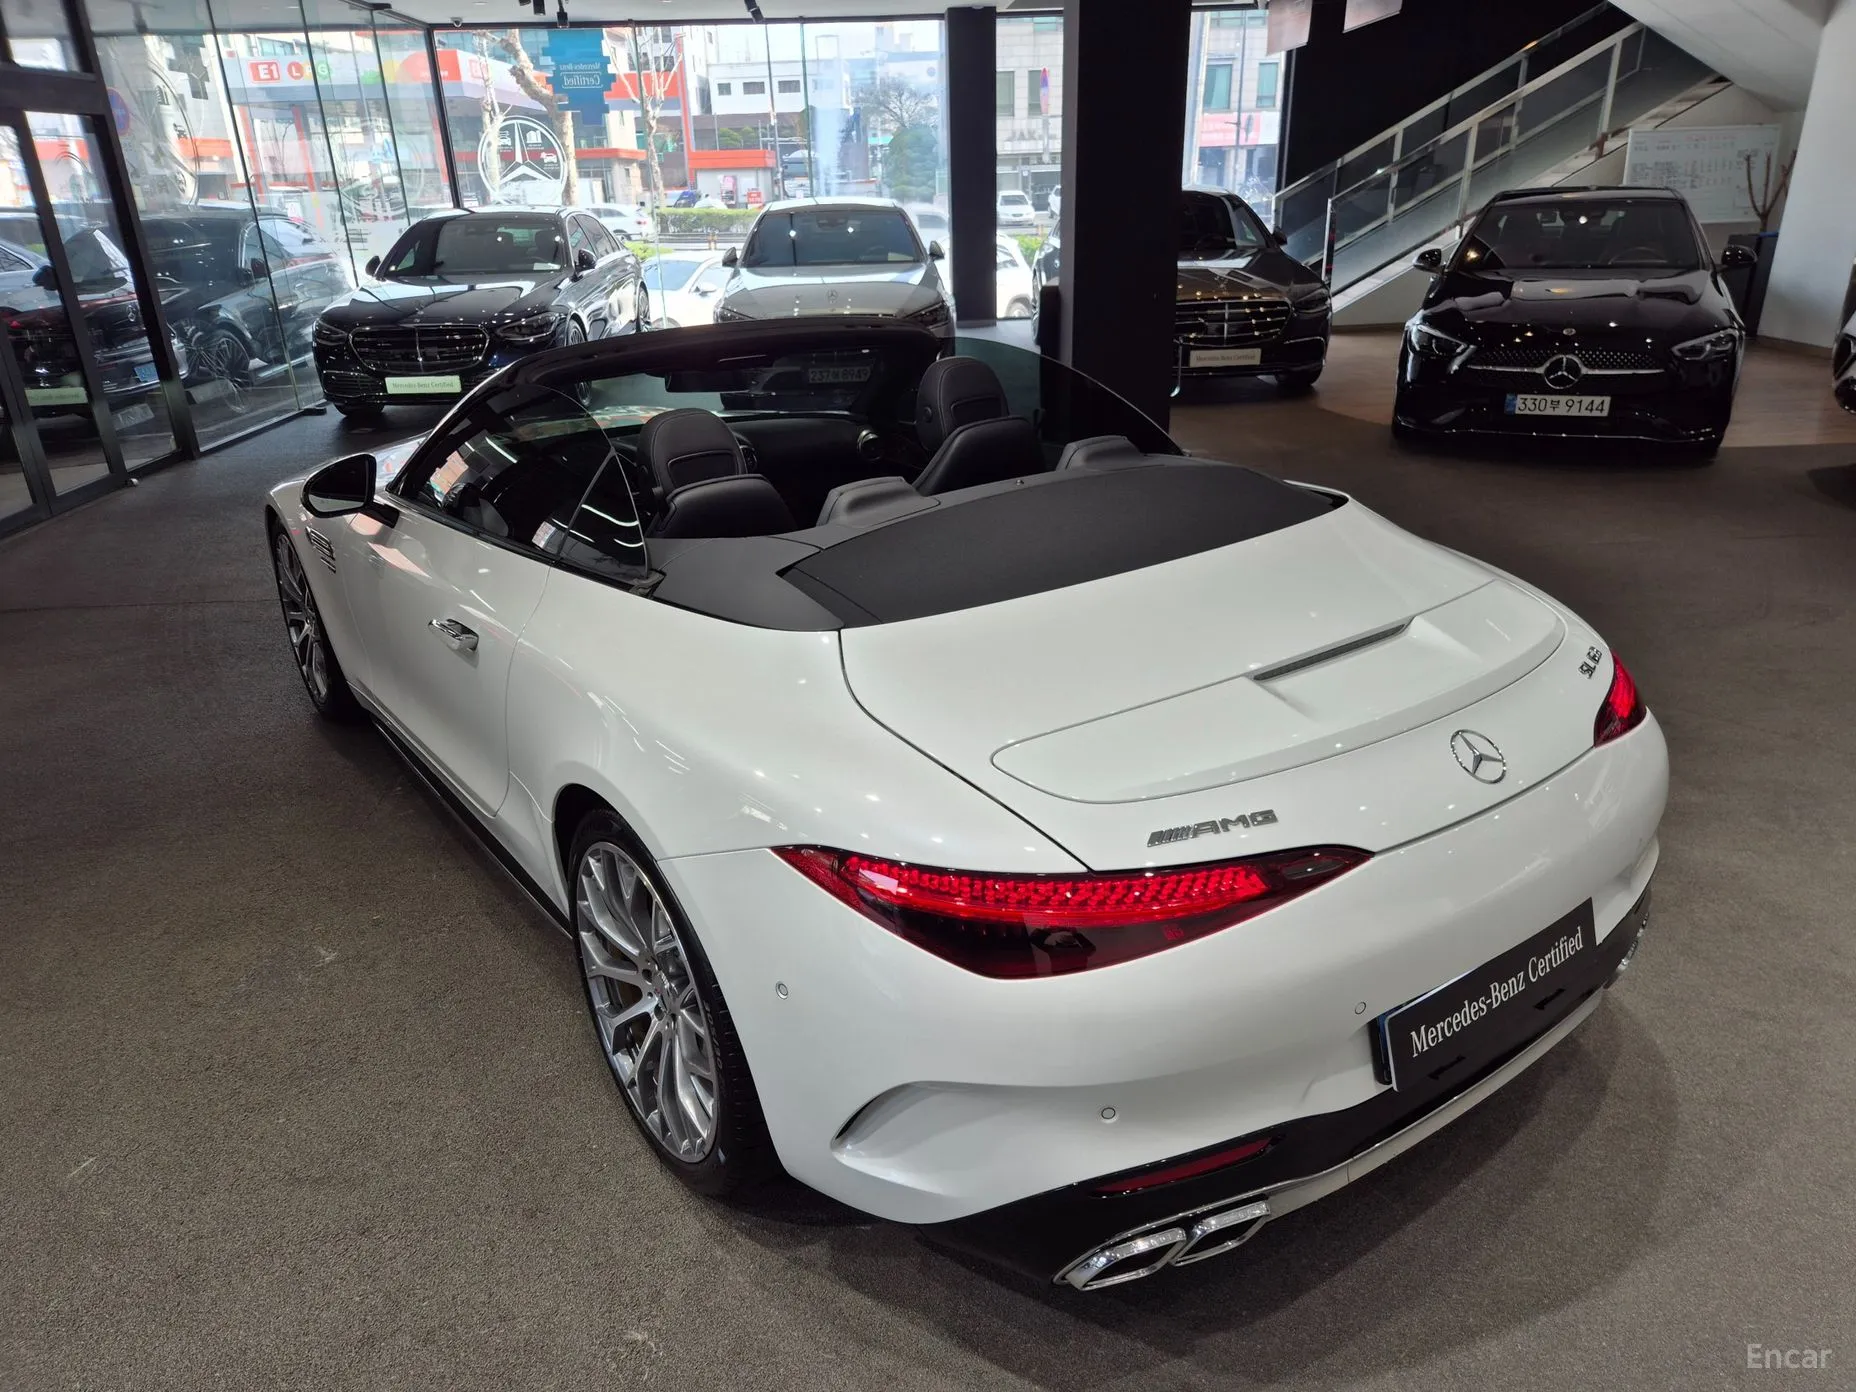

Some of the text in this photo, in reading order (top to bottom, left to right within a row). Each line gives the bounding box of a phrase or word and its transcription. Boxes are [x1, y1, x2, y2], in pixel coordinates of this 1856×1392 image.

[256, 63, 280, 79] E1
[1518, 397, 1605, 413] 330부 9144
[1409, 925, 1584, 1059] Mercedes-Benz Certified
